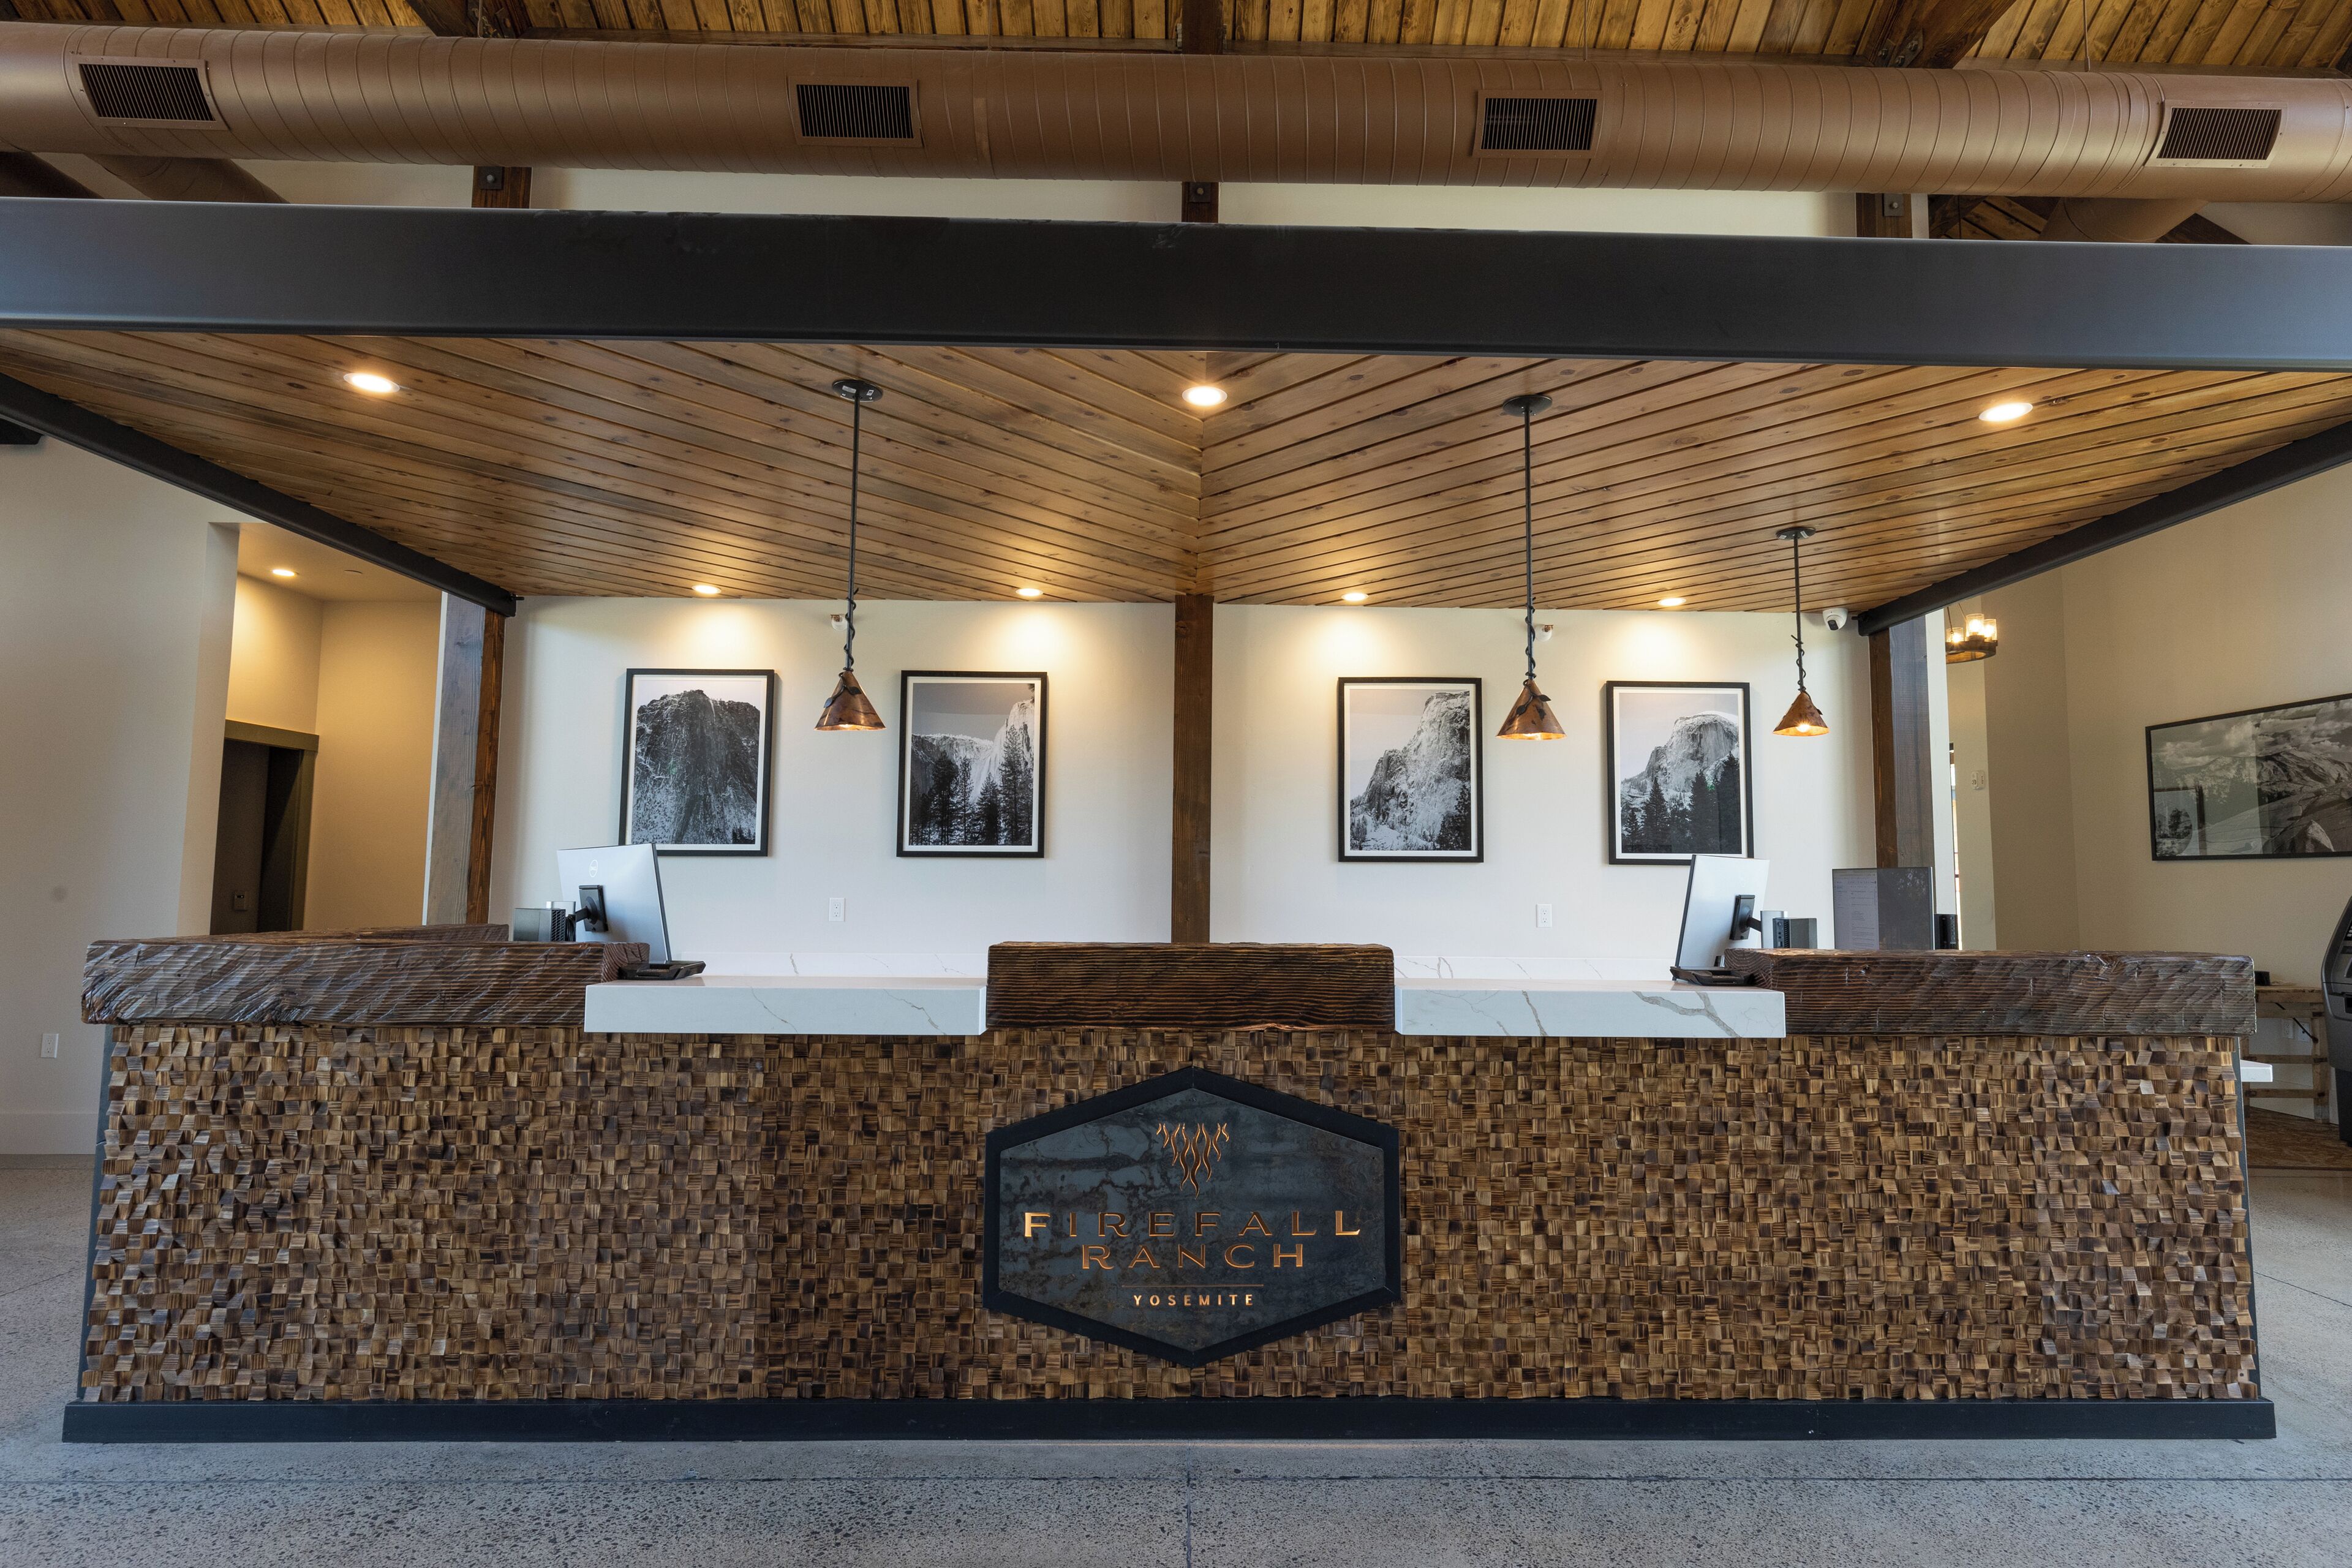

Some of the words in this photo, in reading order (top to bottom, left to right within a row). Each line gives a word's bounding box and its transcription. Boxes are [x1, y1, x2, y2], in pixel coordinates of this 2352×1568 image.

[1025, 1211, 1360, 1237] FIREFALL
[1082, 1243, 1303, 1269] RANCH
[1134, 1294, 1253, 1306] YOSEMITE
